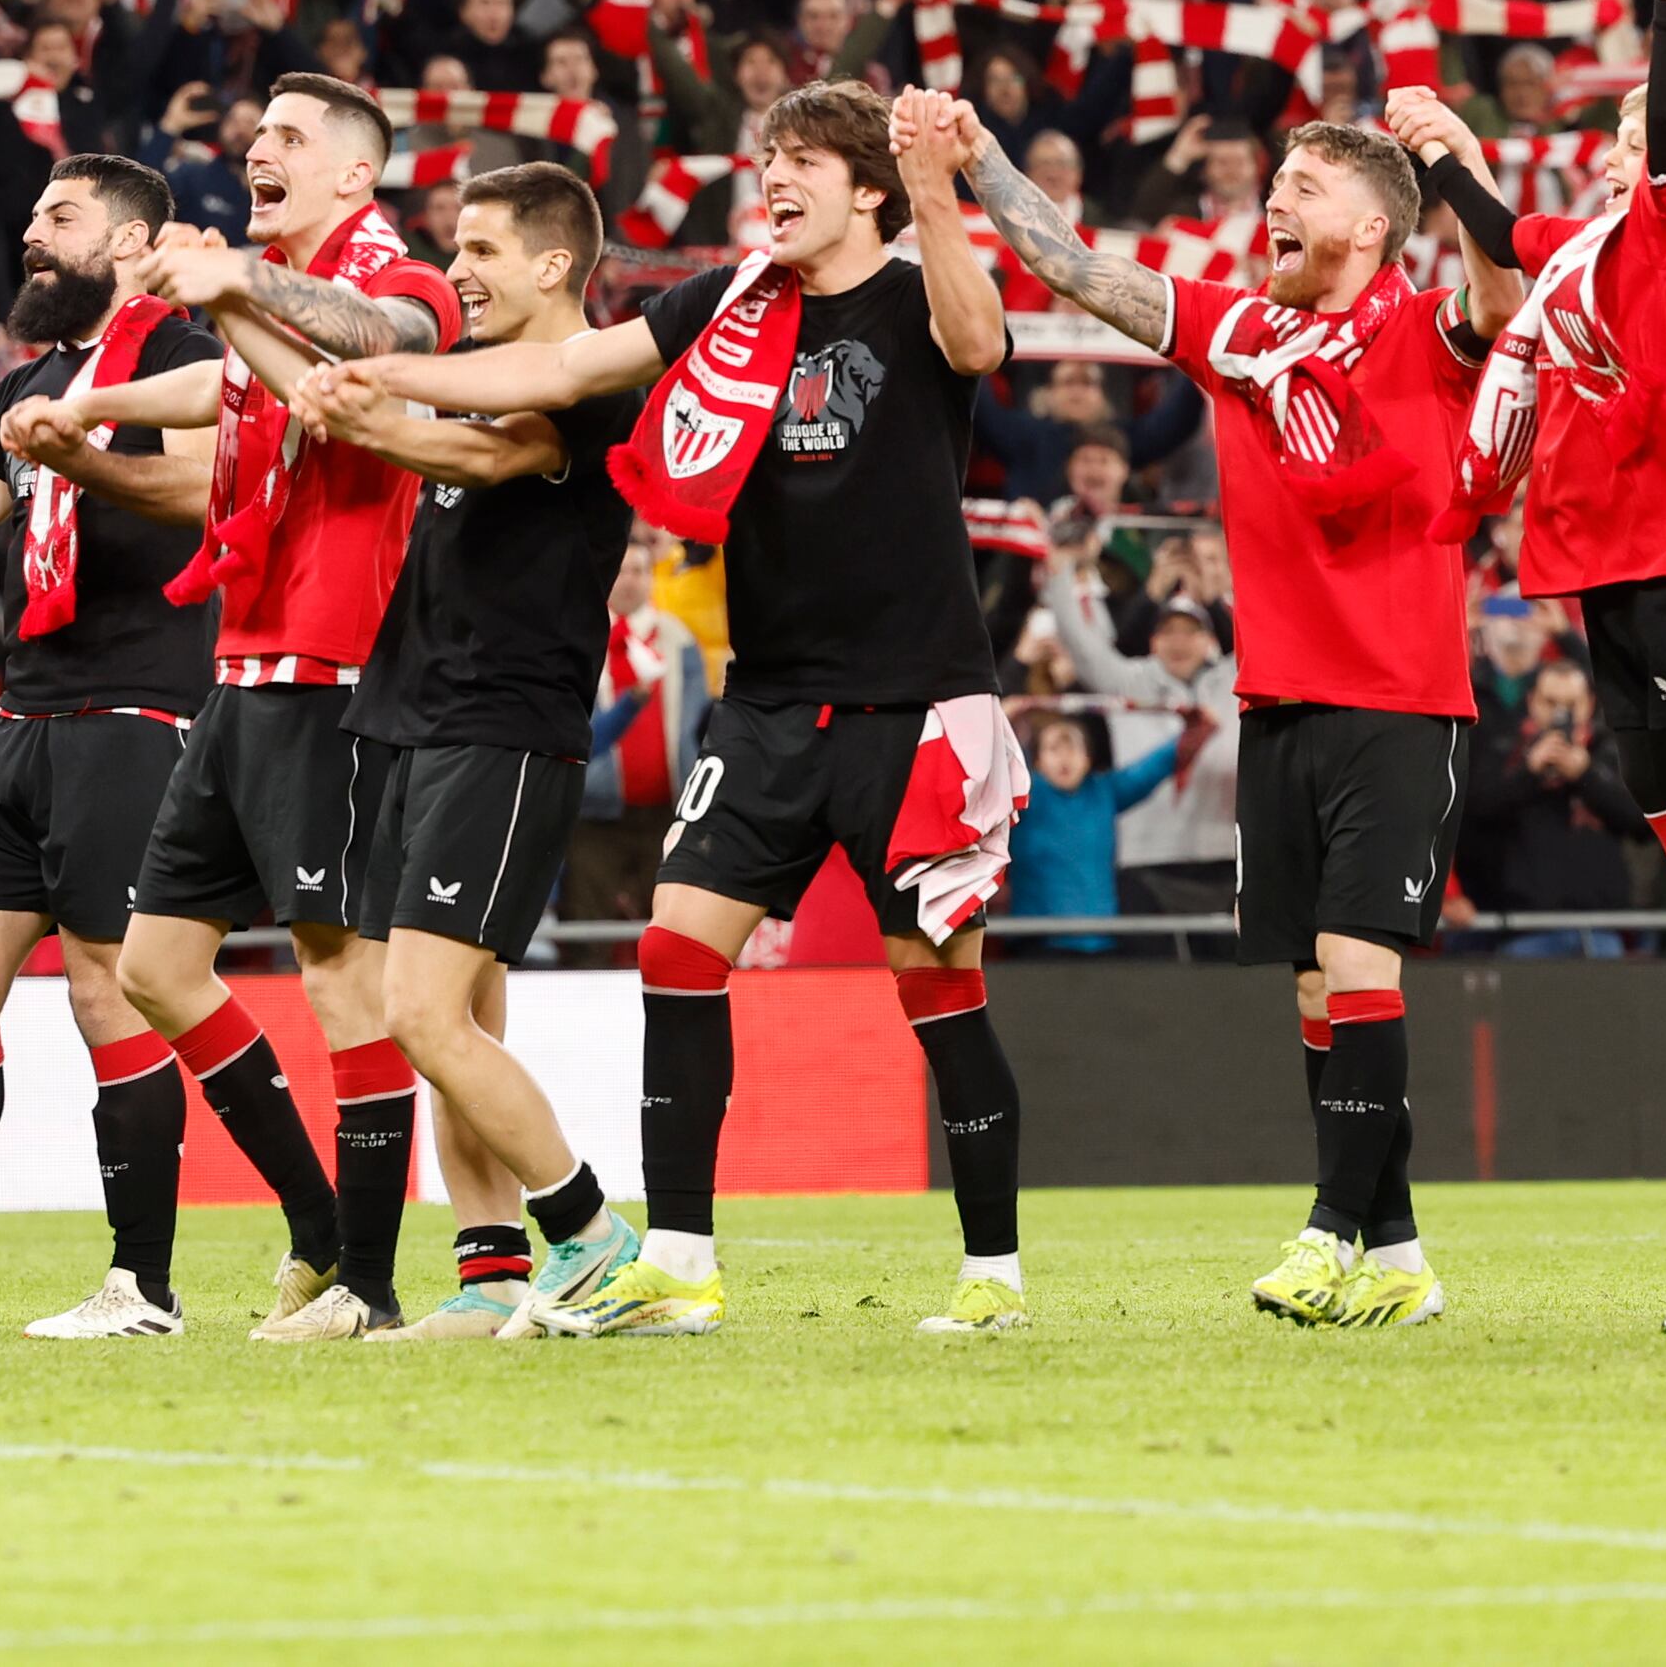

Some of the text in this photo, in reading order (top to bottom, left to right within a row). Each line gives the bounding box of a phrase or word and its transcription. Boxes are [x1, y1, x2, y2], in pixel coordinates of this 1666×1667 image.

[783, 422, 841, 438] UNIQUE IN
[782, 434, 846, 452] THE WORLD
[676, 754, 725, 824] 0
[337, 1130, 403, 1142] ATHLETIC
[350, 1138, 388, 1149] CLUB
